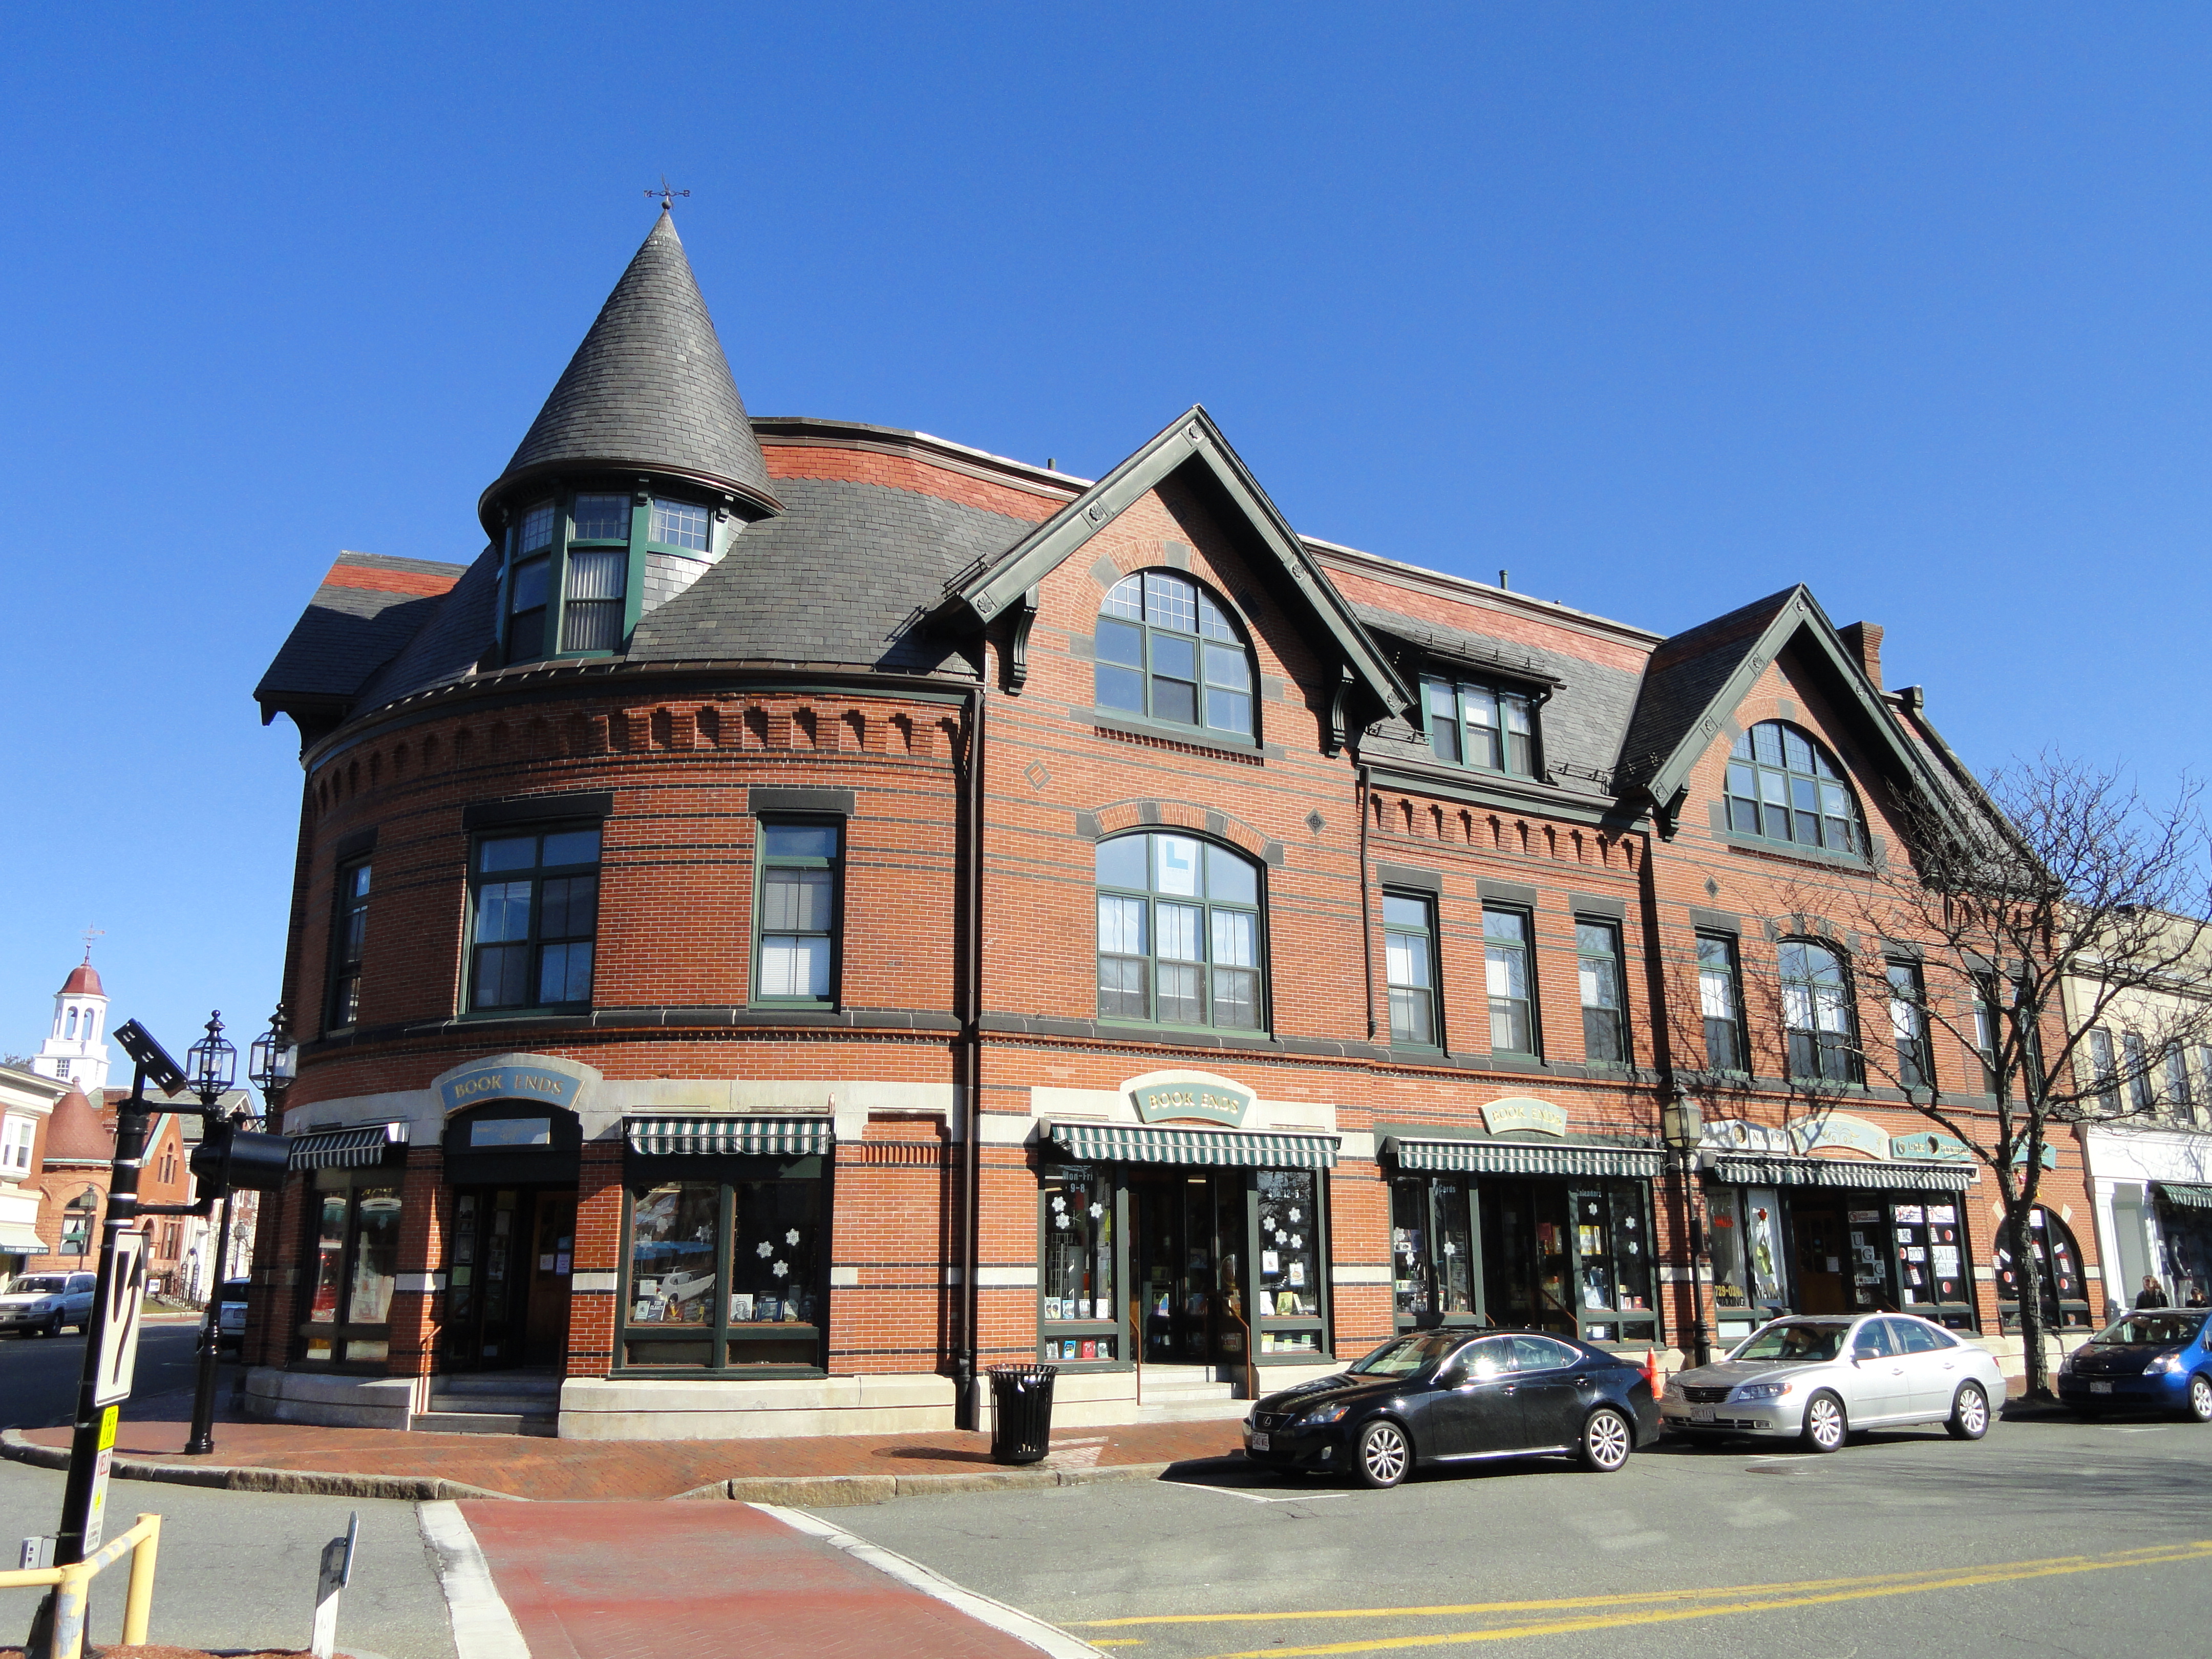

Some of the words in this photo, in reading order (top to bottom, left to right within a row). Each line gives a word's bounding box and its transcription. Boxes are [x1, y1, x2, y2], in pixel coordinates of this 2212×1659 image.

[454, 1075, 502, 1098] BOOK
[515, 1075, 564, 1095] ENDS
[1148, 1091, 1195, 1110] BOOK
[1201, 1093, 1239, 1114] ENDS
[1492, 1107, 1526, 1123] BOOK
[1532, 1108, 1563, 1126] ENDS
[1752, 1132, 1782, 1144] NAILS
[1062, 1171, 1093, 1181] Mon-Fri
[1071, 1183, 1085, 1193] 9-8
[1268, 1188, 1281, 1198] Sun
[1439, 1184, 1456, 1193] Cards
[1932, 1249, 1958, 1260] SALE
[1716, 1296, 1745, 1307] WAXING
[103, 1428, 113, 1444] LAW
[97, 1453, 111, 1476] YIELD
